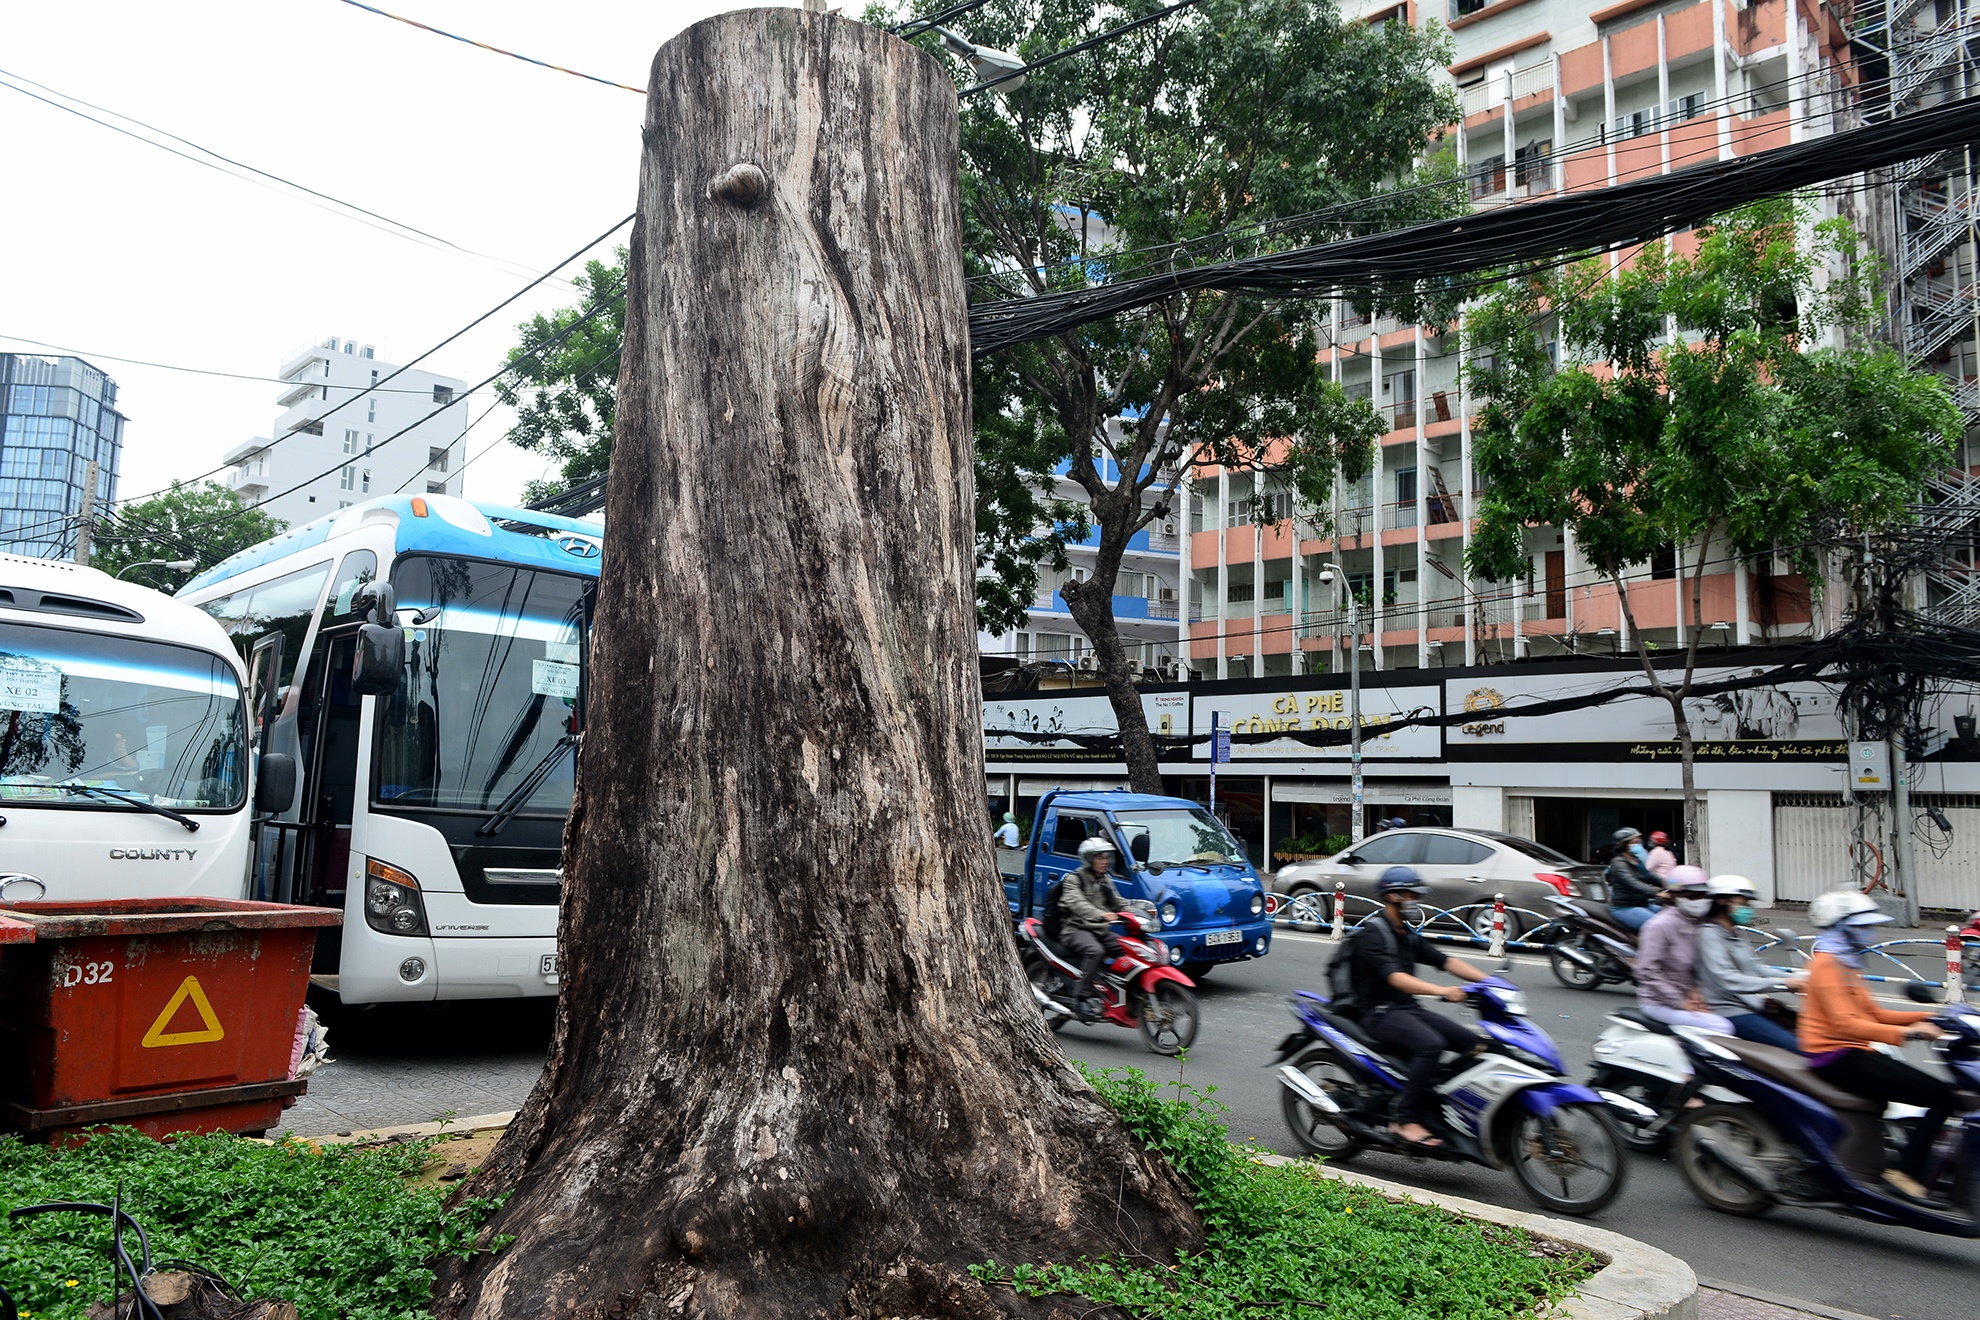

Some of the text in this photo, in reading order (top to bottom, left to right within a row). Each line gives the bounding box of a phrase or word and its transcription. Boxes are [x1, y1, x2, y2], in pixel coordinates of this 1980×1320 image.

[546, 675, 557, 684] XE
[5, 686, 38, 697] XE 02
[1273, 690, 1344, 714] CÀ PHÊ
[1461, 721, 1505, 738] Legend
[109, 847, 198, 861] COUNTY
[435, 923, 490, 931] UNIVERSE
[63, 960, 114, 988] D32
